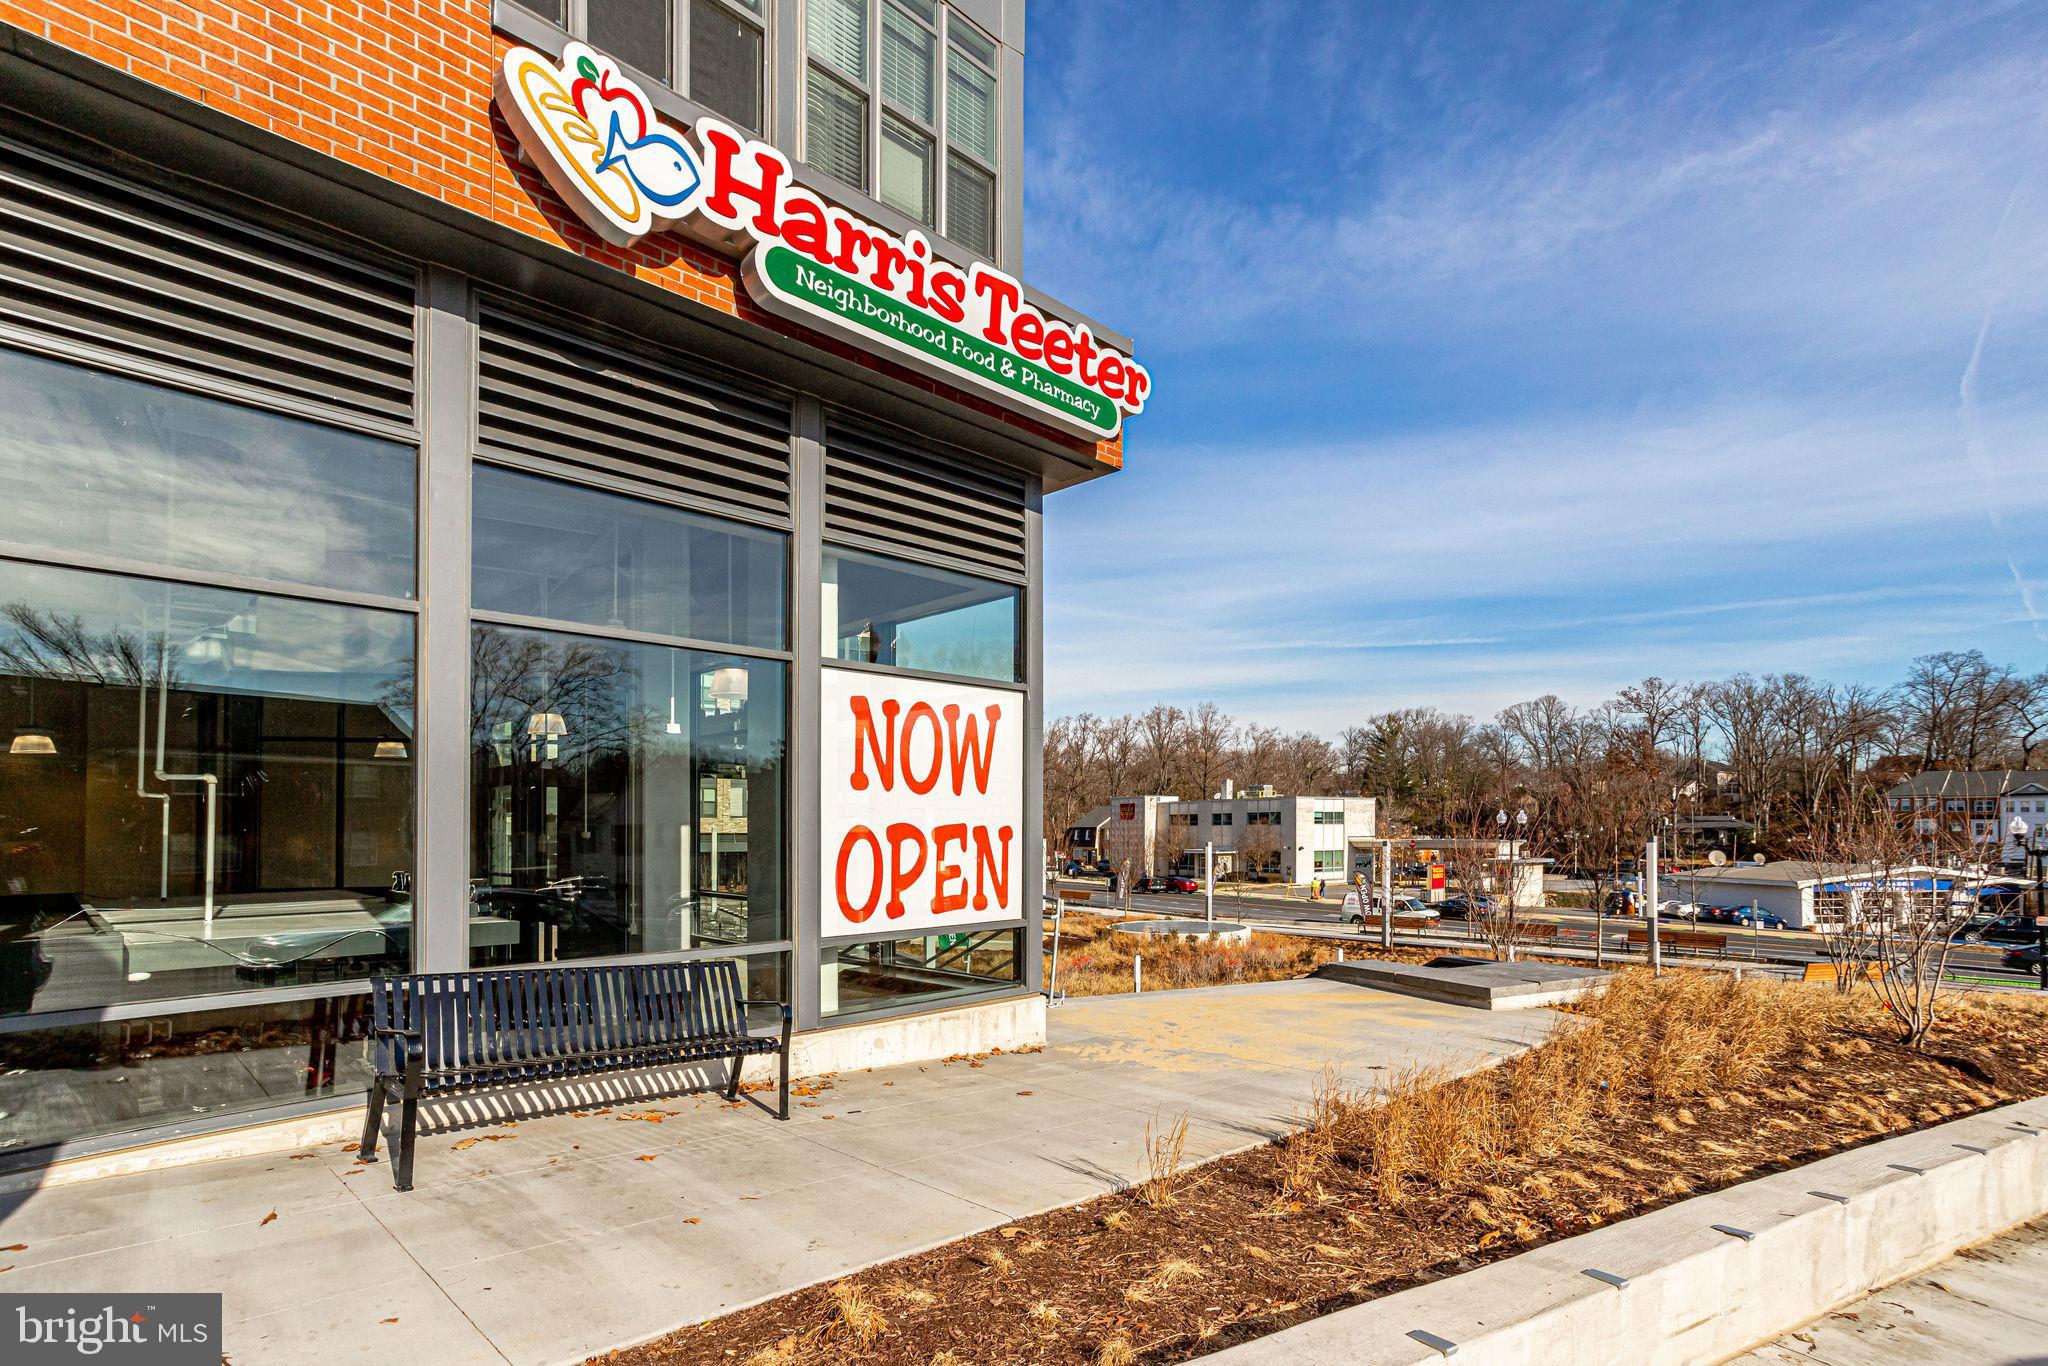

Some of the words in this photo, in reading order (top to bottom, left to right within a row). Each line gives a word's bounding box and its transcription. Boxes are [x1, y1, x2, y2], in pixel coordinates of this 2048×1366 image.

[706, 129, 965, 323] Harris
[974, 271, 1148, 407] Teeter
[795, 264, 948, 351] Neighborhood
[951, 336, 996, 372] Food
[1000, 359, 1016, 380] &
[1021, 366, 1101, 419] Pharmacy
[849, 695, 1002, 796] NOW
[835, 822, 1014, 923] OPEN
